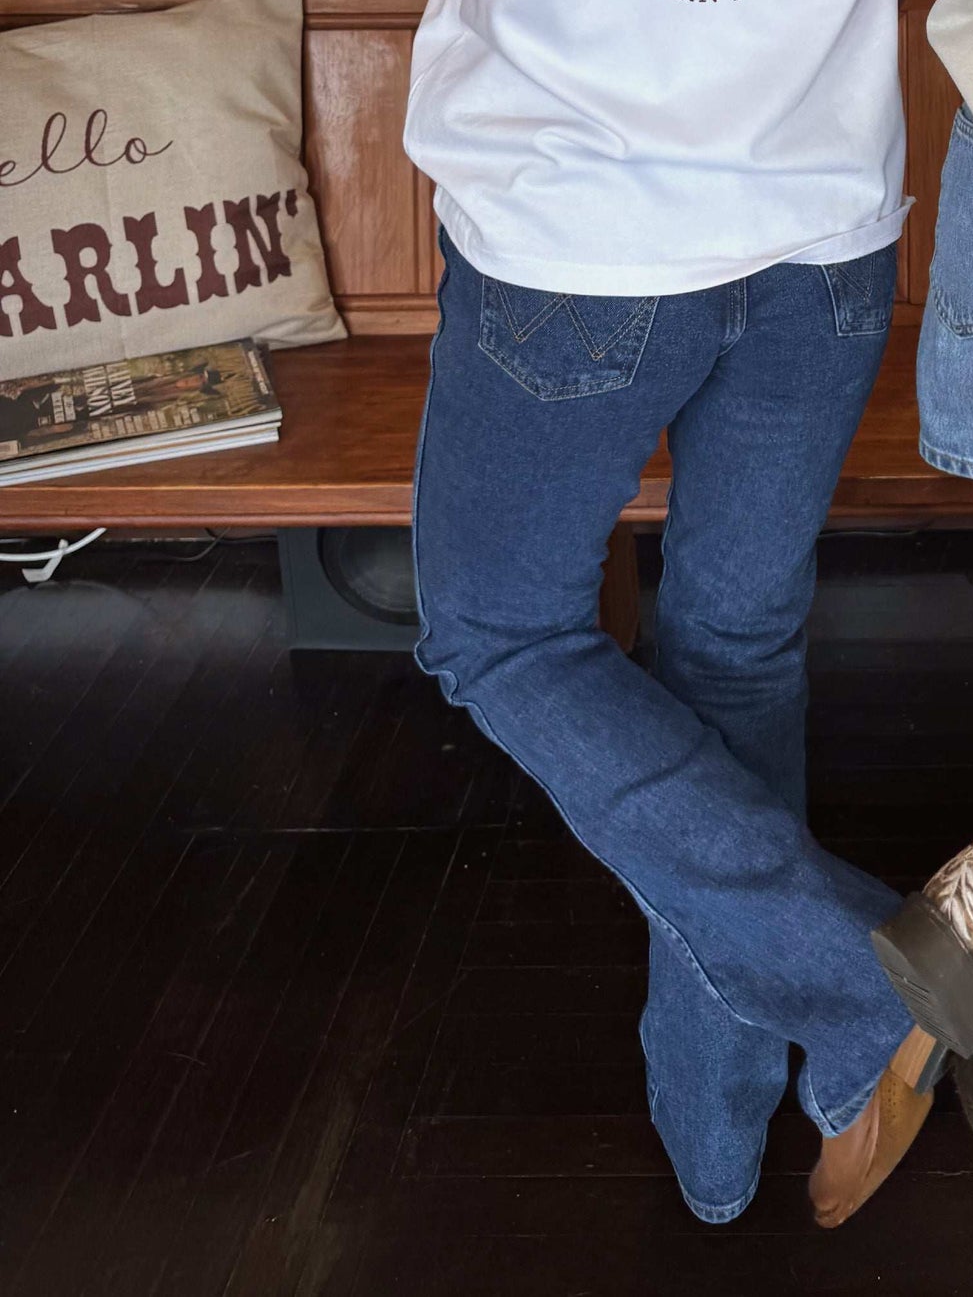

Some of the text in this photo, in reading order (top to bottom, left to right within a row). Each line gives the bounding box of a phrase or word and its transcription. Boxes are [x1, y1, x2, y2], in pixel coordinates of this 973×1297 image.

[0, 108, 174, 187] ello
[0, 188, 299, 338] ARLIN'
[82, 365, 113, 417] WILSON
